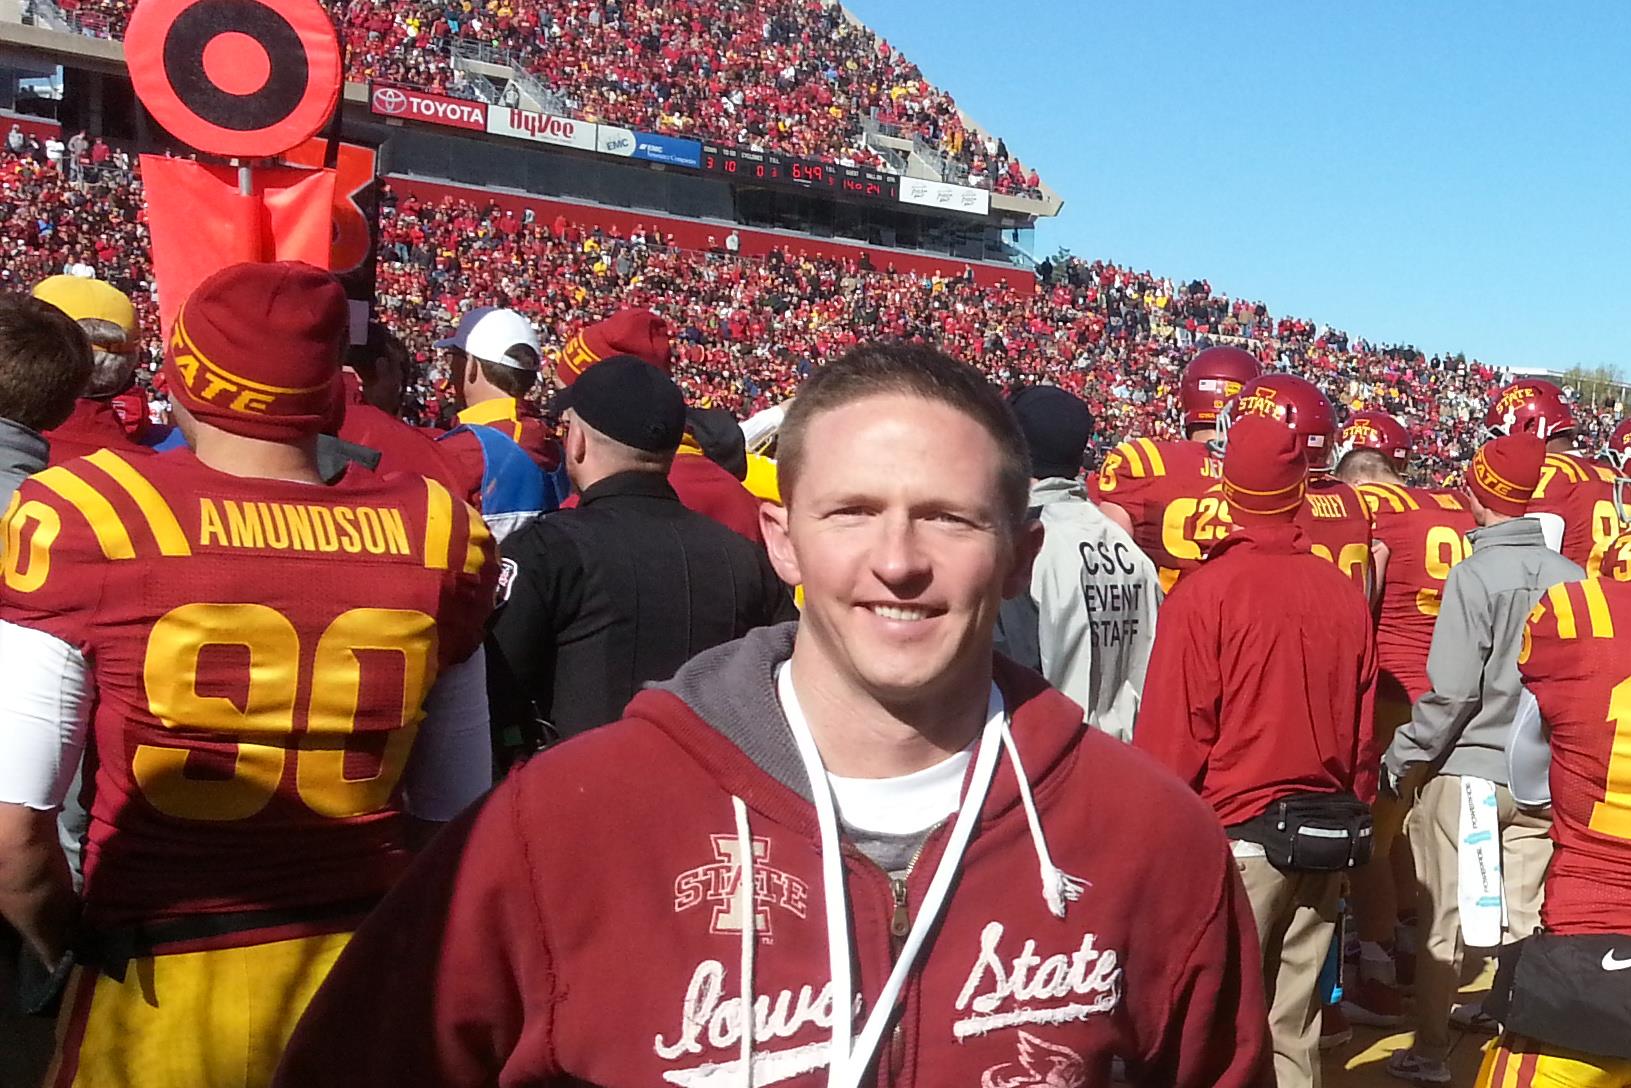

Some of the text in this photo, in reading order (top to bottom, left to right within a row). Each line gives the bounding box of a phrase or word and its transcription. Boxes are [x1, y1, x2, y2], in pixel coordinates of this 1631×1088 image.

[409, 97, 484, 125] TOYOTA
[606, 137, 630, 151] EMC
[706, 156, 713, 169] 3
[725, 160, 736, 172] 10
[757, 165, 764, 177] 0
[867, 183, 880, 195] 24
[1238, 396, 1281, 421] STATE
[1306, 493, 1348, 518] SEELEY
[200, 496, 411, 556] AMUNDSON
[1079, 541, 1135, 577] CSC
[1416, 526, 1473, 616] 9
[1085, 582, 1142, 614] EVENT
[1090, 619, 1140, 648] STAFF
[133, 602, 440, 821] 90
[674, 863, 807, 920] STATE
[954, 921, 1123, 1013] State
